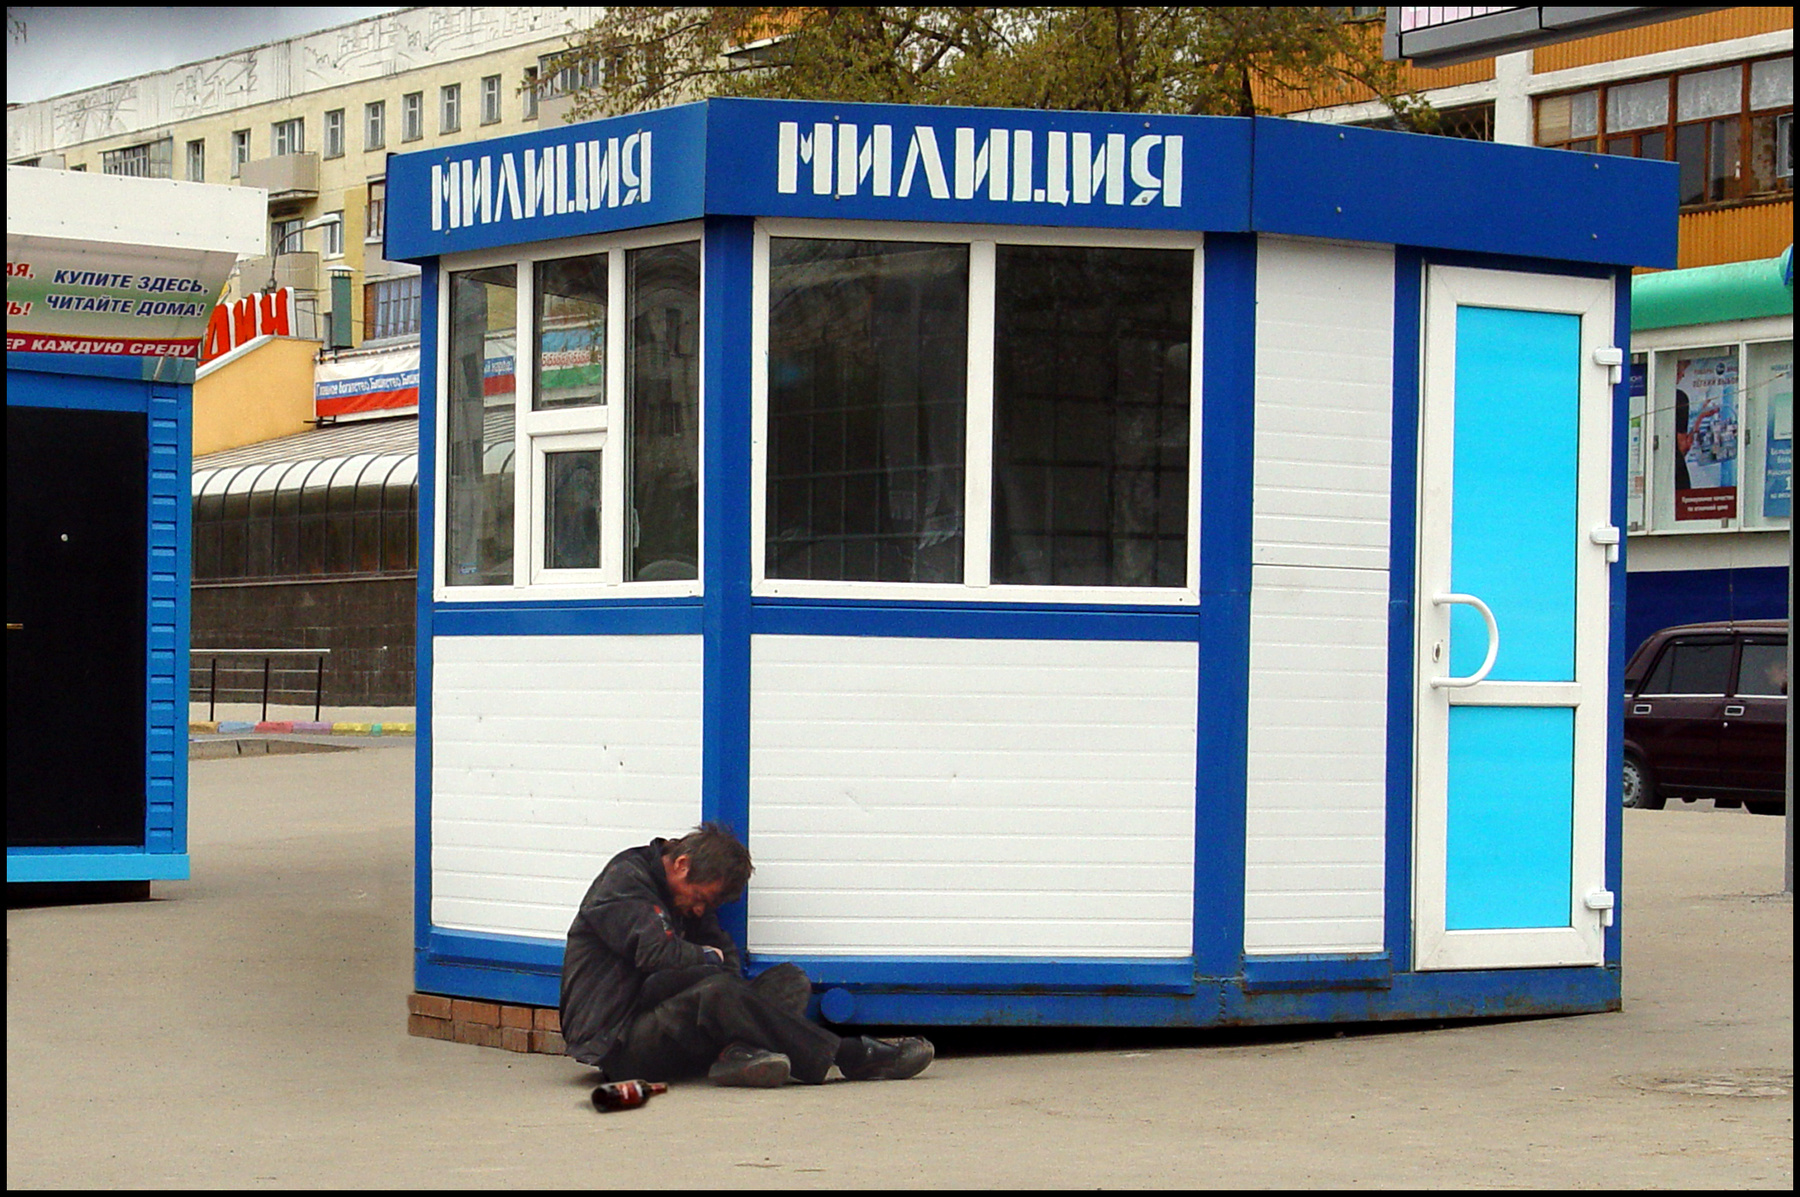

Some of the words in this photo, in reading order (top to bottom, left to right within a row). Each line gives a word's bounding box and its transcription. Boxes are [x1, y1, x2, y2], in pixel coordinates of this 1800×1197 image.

[778, 122, 1183, 206] МИЛИЦИЯ
[432, 131, 651, 231] МИЛИЦИЯ
[54, 270, 133, 289] КУПИТЕ
[137, 276, 209, 295] ЗДЕСЬ,
[47, 295, 133, 314] ЧИТАЙТЕ
[136, 302, 206, 317] ДОМА!
[31, 339, 124, 355] КАЖДУЮ
[129, 342, 195, 357] СРЕДУ
